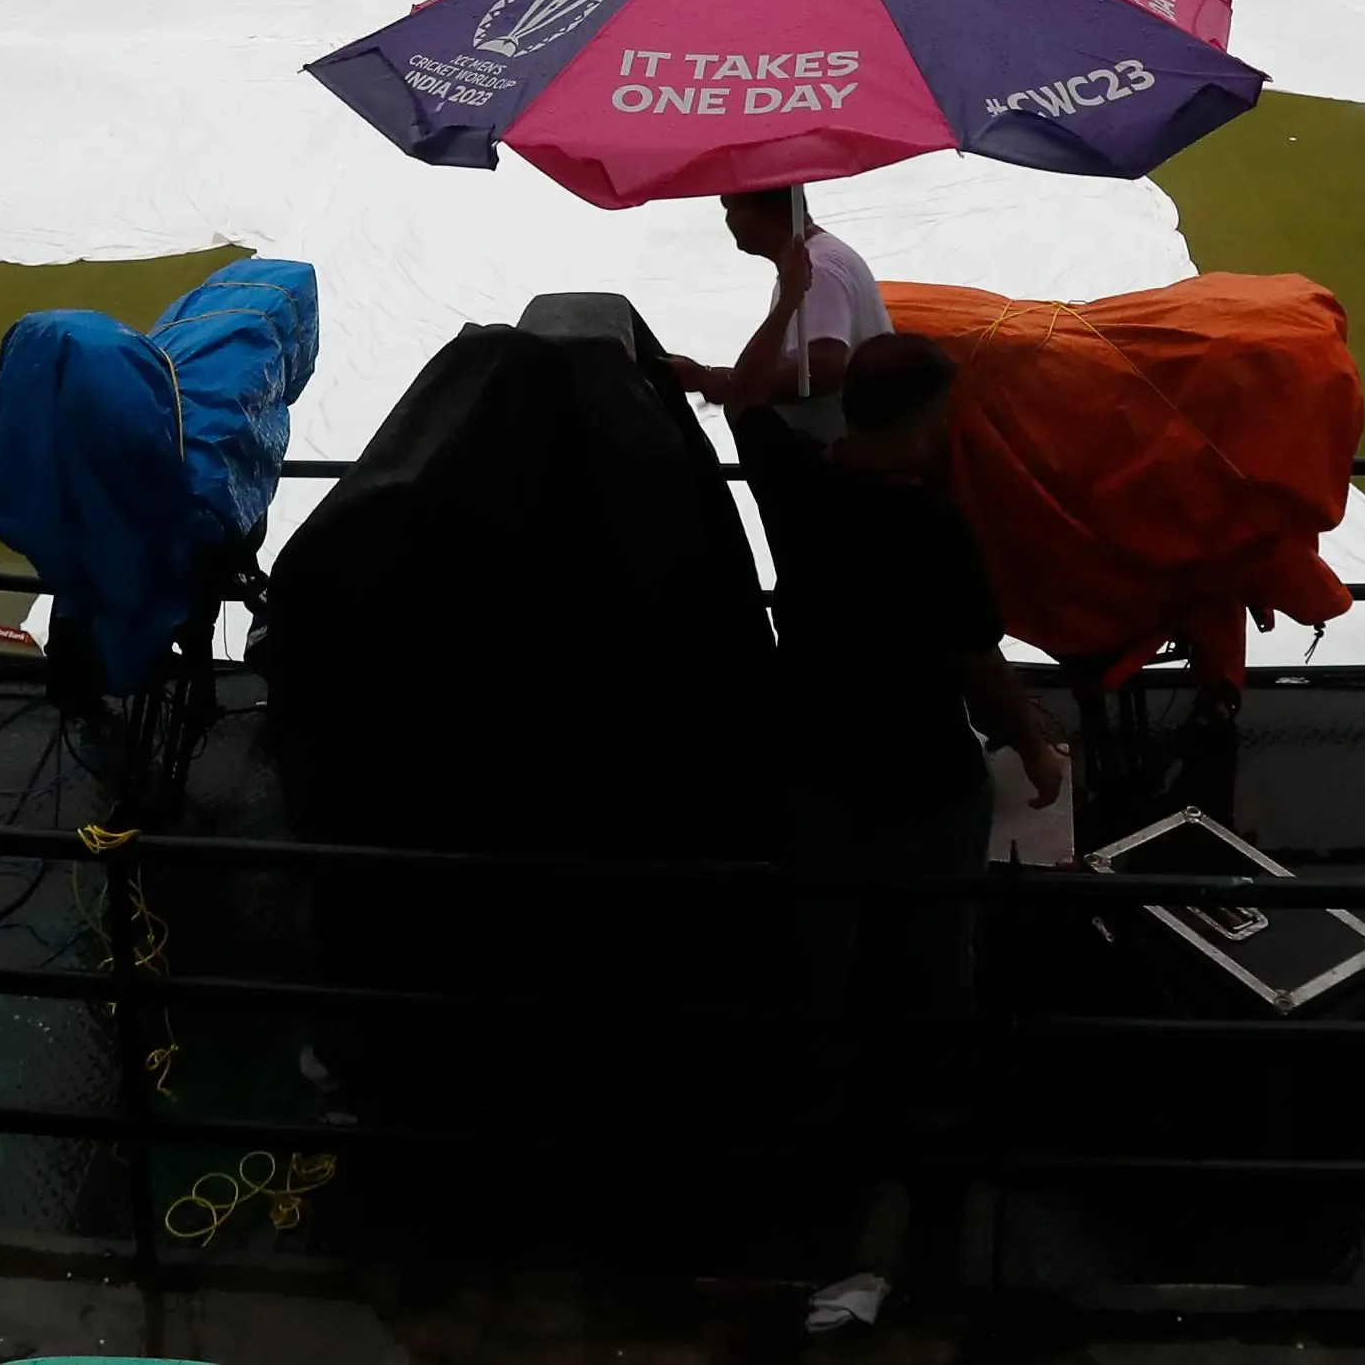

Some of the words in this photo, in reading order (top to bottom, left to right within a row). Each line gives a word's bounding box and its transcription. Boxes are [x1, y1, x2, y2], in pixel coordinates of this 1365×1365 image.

[409, 54, 459, 77] CRICKET
[457, 66, 495, 88] WORLD
[491, 77, 517, 89] CUP
[450, 55, 474, 66] ICC
[474, 57, 508, 75] MEN'S
[619, 49, 671, 78] IT
[685, 51, 859, 80] TAKES
[404, 70, 452, 98] INDIA
[447, 84, 493, 107] 2023
[611, 84, 731, 115] ONE
[743, 82, 859, 115] DAY
